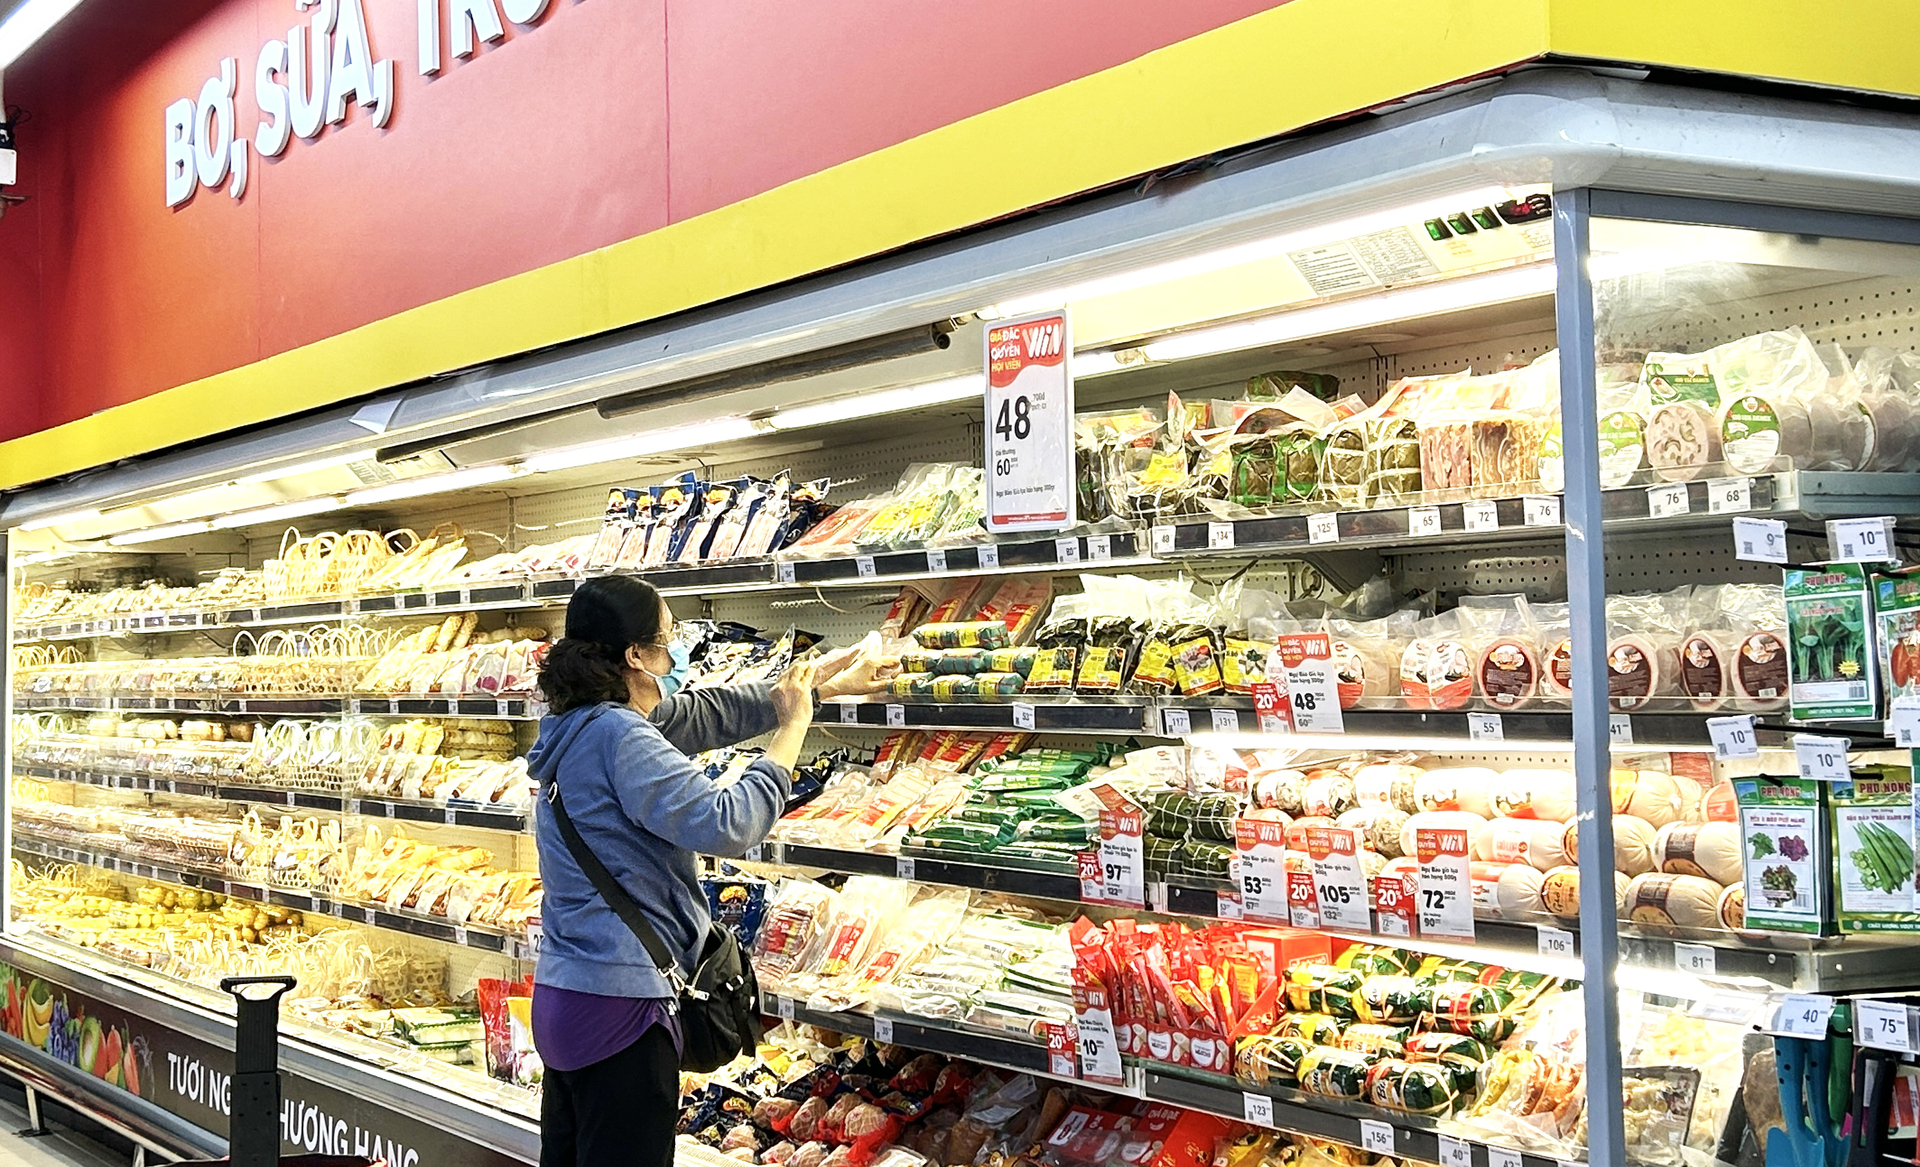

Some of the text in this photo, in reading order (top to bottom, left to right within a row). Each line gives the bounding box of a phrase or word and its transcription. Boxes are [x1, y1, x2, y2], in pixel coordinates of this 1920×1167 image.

[165, 57, 248, 207] BƠ,
[995, 395, 1031, 442] 48
[996, 458, 1011, 476] 60
[1666, 493, 1680, 504] 76
[1726, 489, 1740, 502] 68
[1478, 511, 1489, 522] 72
[1539, 505, 1551, 516] 76
[1317, 522, 1331, 533] 125
[1422, 515, 1434, 528] 65
[1766, 532, 1775, 546] 9
[1858, 530, 1875, 546] 10
[1255, 693, 1278, 709] 20%
[1294, 692, 1316, 711] 48
[1172, 718, 1184, 727] 117
[1483, 722, 1495, 733] 55
[1610, 724, 1622, 735] 41
[1729, 729, 1745, 744] 10
[1816, 753, 1833, 768] 10
[1883, 779, 1912, 794] NÔNG
[1080, 862, 1099, 877] 20%
[1105, 863, 1122, 881] 97
[1244, 875, 1262, 894] 53
[1291, 883, 1314, 901] 20%
[1319, 884, 1350, 904] 105
[1377, 888, 1403, 907] 20%
[1422, 889, 1445, 909] 72
[1324, 911, 1338, 920] 132
[1423, 917, 1436, 927] 90
[533, 934, 544, 953] 2
[1548, 939, 1565, 952] 106
[1691, 956, 1704, 968] 81
[1802, 1008, 1818, 1024] 40
[1879, 1017, 1897, 1034] 75
[1048, 1033, 1067, 1050] 20%
[1082, 1038, 1098, 1056] 10
[167, 1052, 206, 1105] TƯƠI
[1252, 1104, 1266, 1117] 123
[1370, 1131, 1387, 1144] 156
[1452, 1148, 1463, 1161] 40
